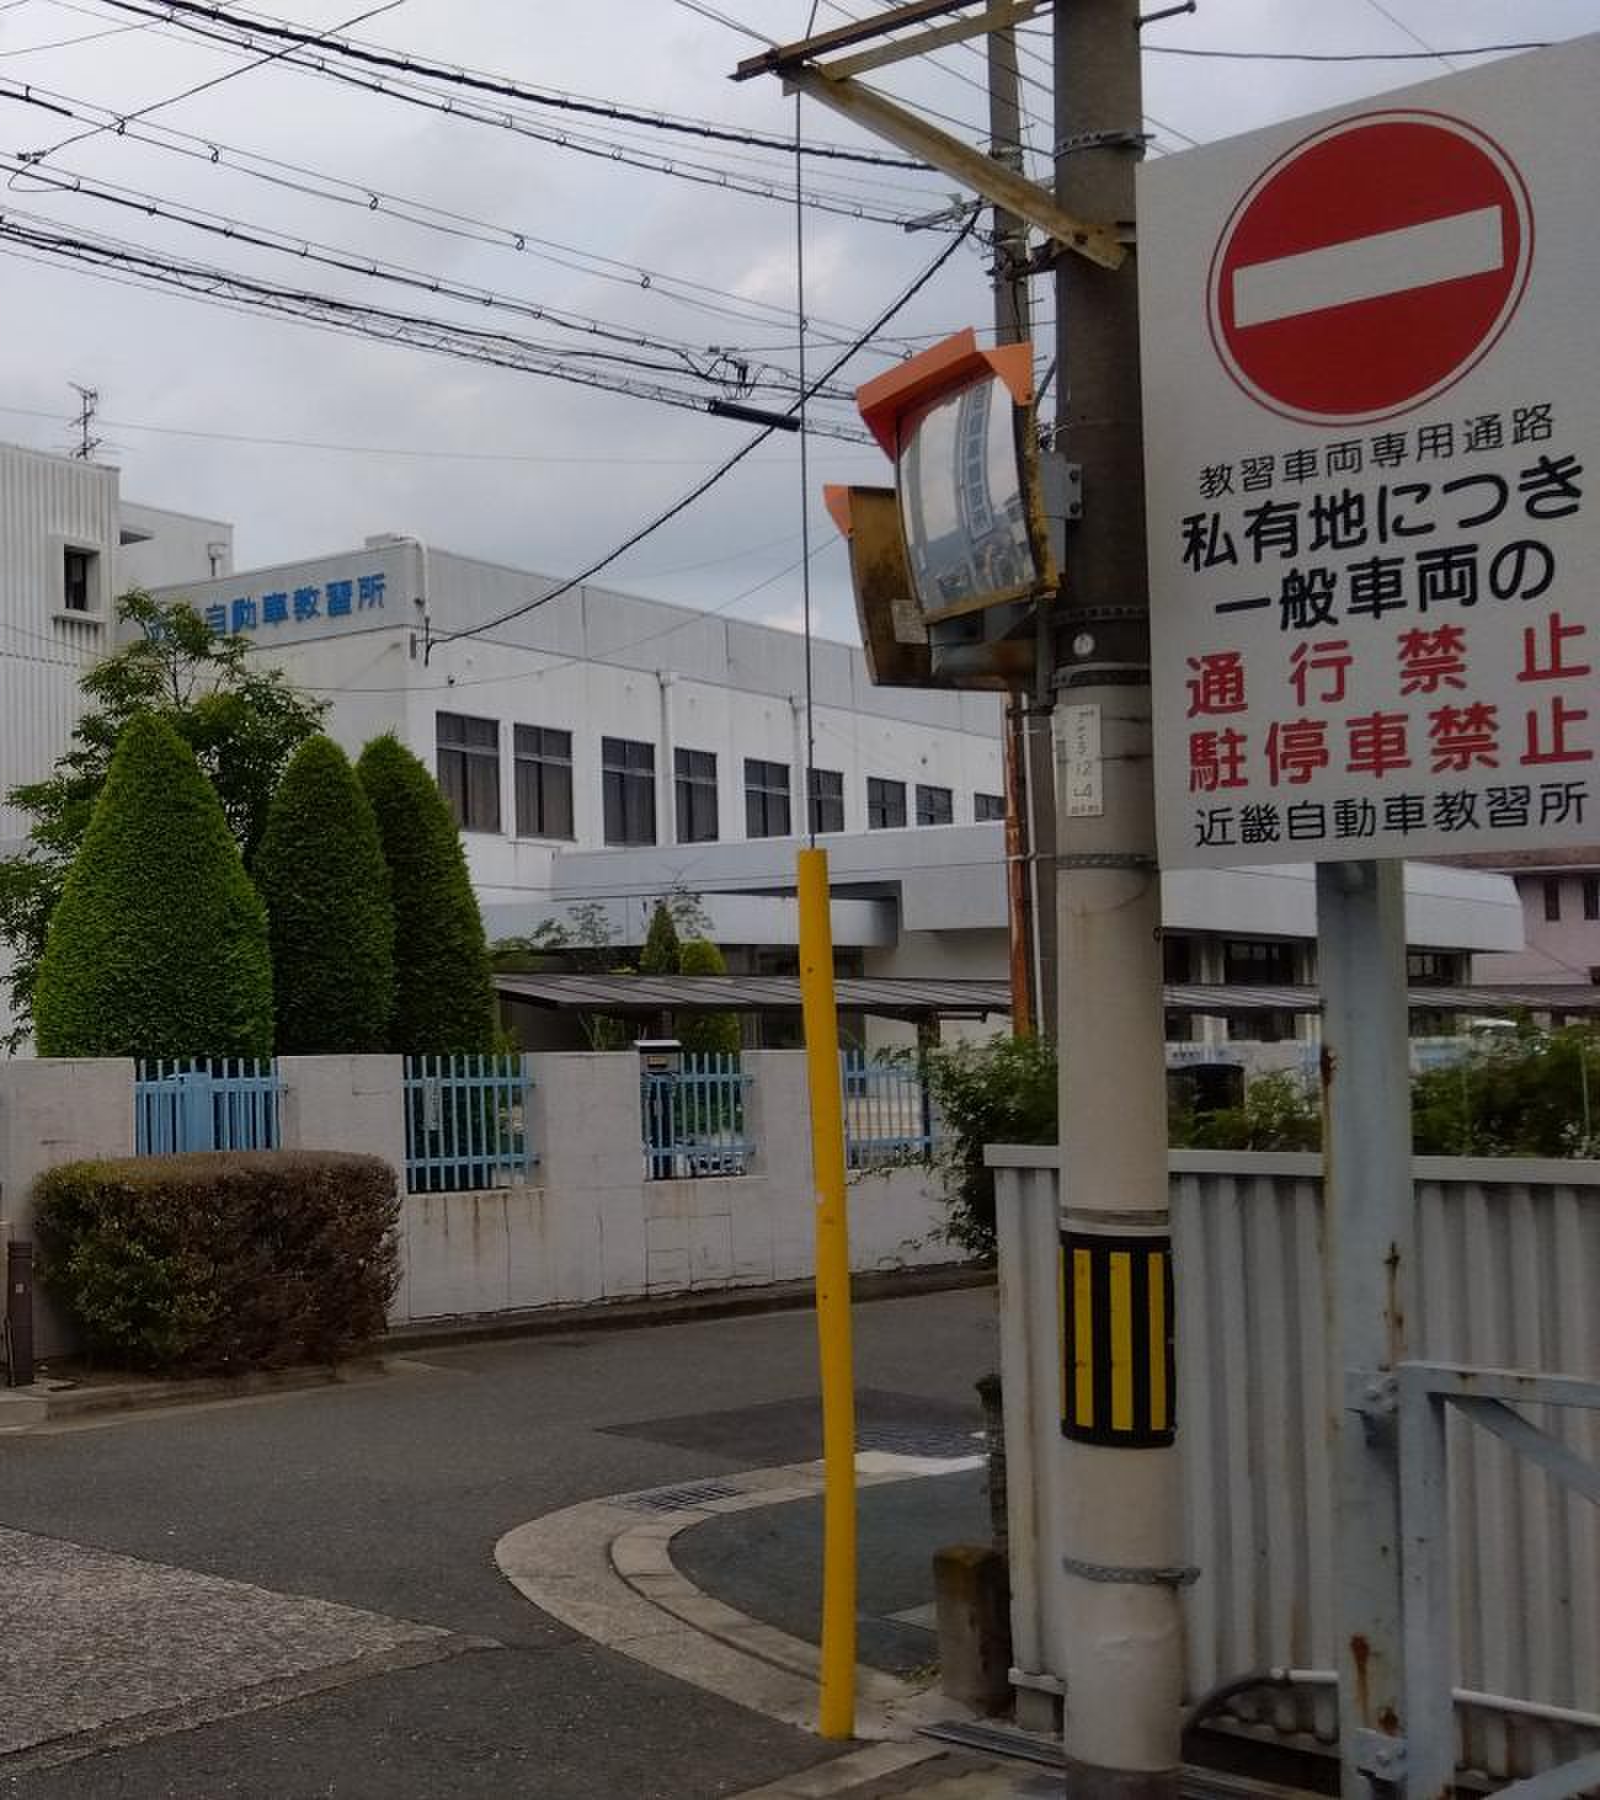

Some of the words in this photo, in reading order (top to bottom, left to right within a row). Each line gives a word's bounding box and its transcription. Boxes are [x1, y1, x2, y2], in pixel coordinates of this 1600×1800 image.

[1200, 402, 1554, 498] 教習車両専用通路
[1181, 454, 1583, 572] 私有地につき
[148, 573, 385, 641] 自動車教習所
[1215, 539, 1555, 631] 一般車両の
[1185, 612, 1591, 719] 通行禁止
[1188, 696, 1594, 793] 駐停車禁止
[1195, 781, 1590, 848] 近畿自動車教習所
